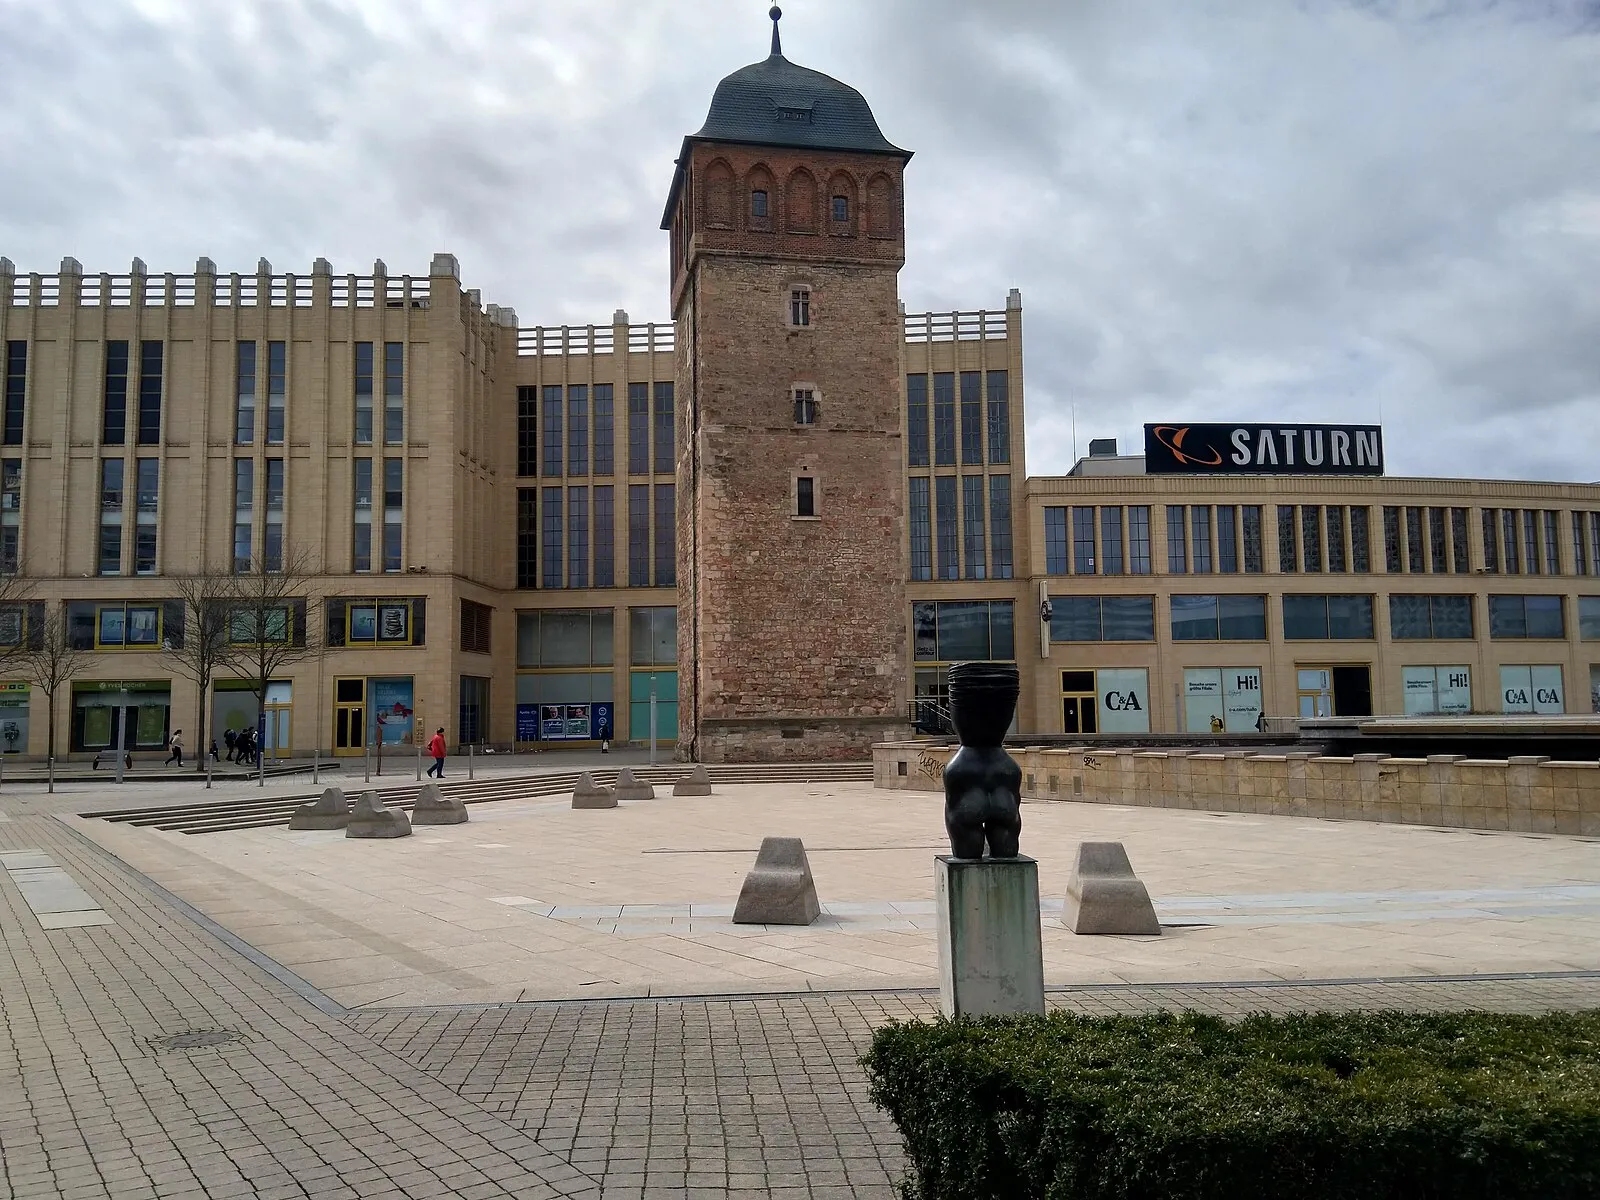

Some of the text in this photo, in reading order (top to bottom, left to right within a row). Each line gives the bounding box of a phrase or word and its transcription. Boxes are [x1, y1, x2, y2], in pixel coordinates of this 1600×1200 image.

[1231, 429, 1378, 465] SATURN
[1237, 675, 1259, 690] Hi!
[1449, 673, 1468, 688] Hi!
[1105, 691, 1143, 711] C&A
[1505, 689, 1528, 704] C&A
[1536, 688, 1560, 704] C&A
